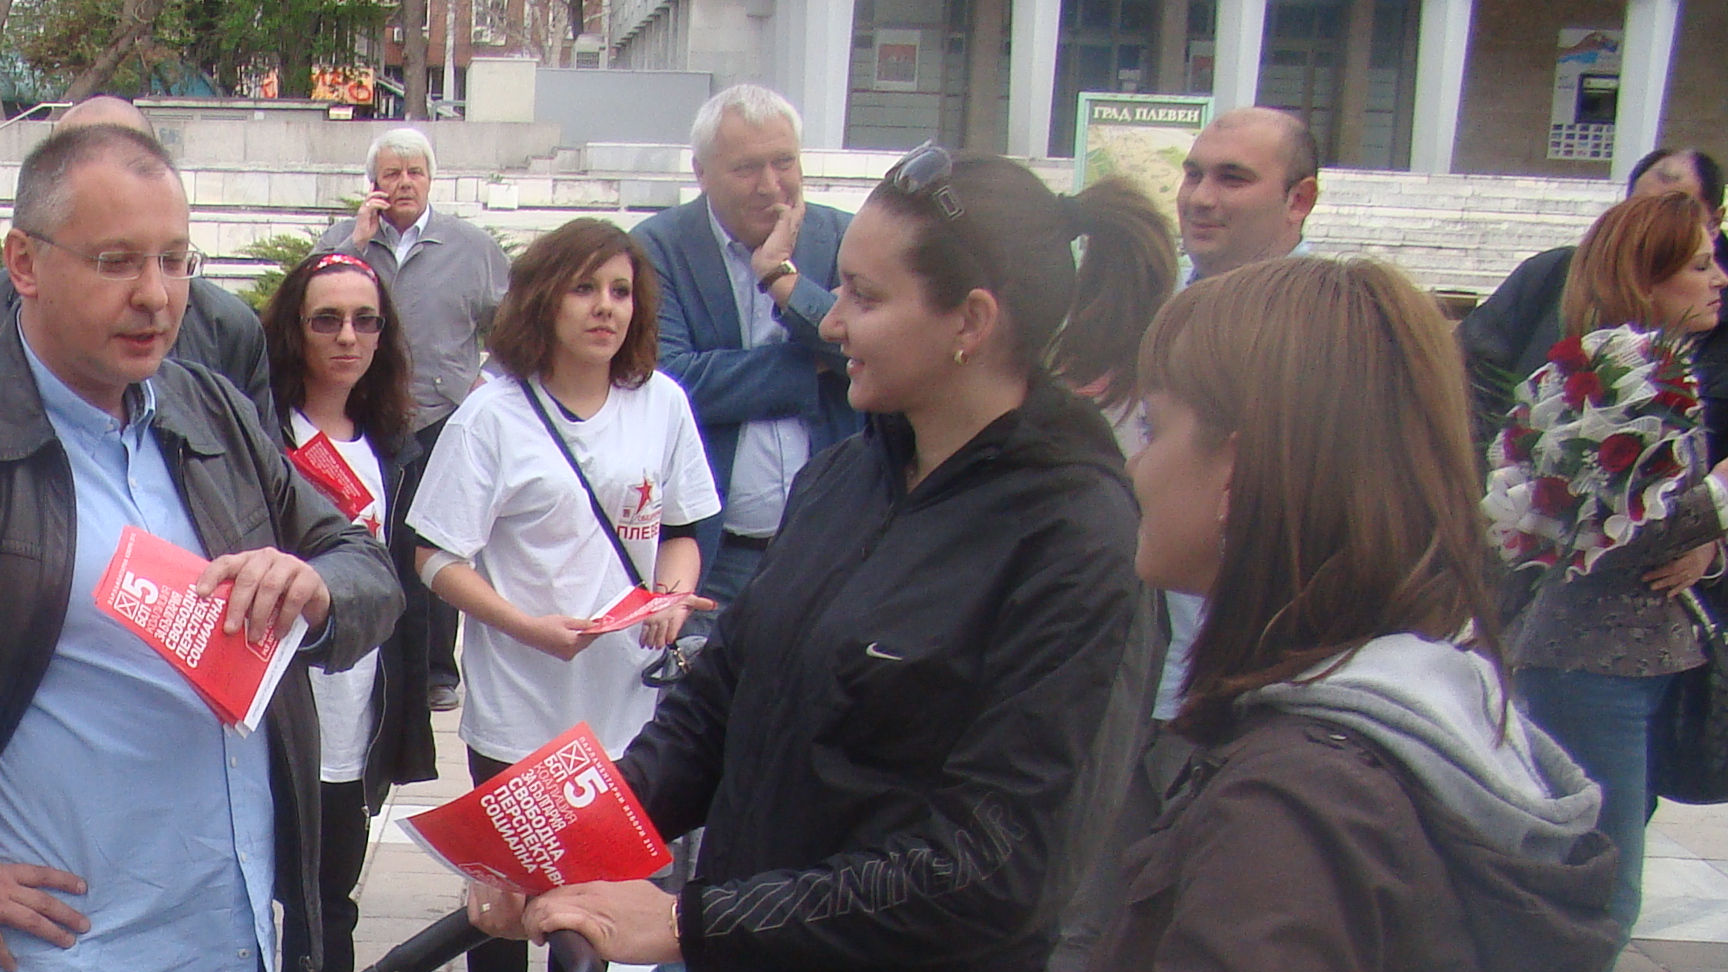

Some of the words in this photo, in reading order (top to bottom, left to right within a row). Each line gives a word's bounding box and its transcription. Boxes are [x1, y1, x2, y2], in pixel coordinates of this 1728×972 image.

[1093, 106, 1132, 121] ГРАД
[1135, 107, 1200, 122] ПЛЕВЕН
[122, 571, 158, 604] 5
[135, 604, 151, 627] БСП
[159, 590, 183, 632] БЪЛГАРИЯ
[175, 592, 214, 660] ПЕРСПЕК
[184, 598, 225, 668] СОЦИАЛНА
[154, 629, 167, 642] ЗА
[521, 769, 536, 785] ЗА
[544, 754, 567, 782] БСП
[564, 766, 608, 808] 5
[578, 736, 624, 803] ПАРЛАМЕНТАРНИ
[623, 805, 645, 836] ИЗБОРИ
[528, 780, 566, 831] БЪЛГАРИЯ
[533, 761, 577, 824] КОАЛИЦИЯ
[481, 795, 537, 873] СОЦИАЛНА
[494, 785, 565, 886] ПЕРСПЕКТИВ
[509, 777, 564, 861] СВОБОДНА
